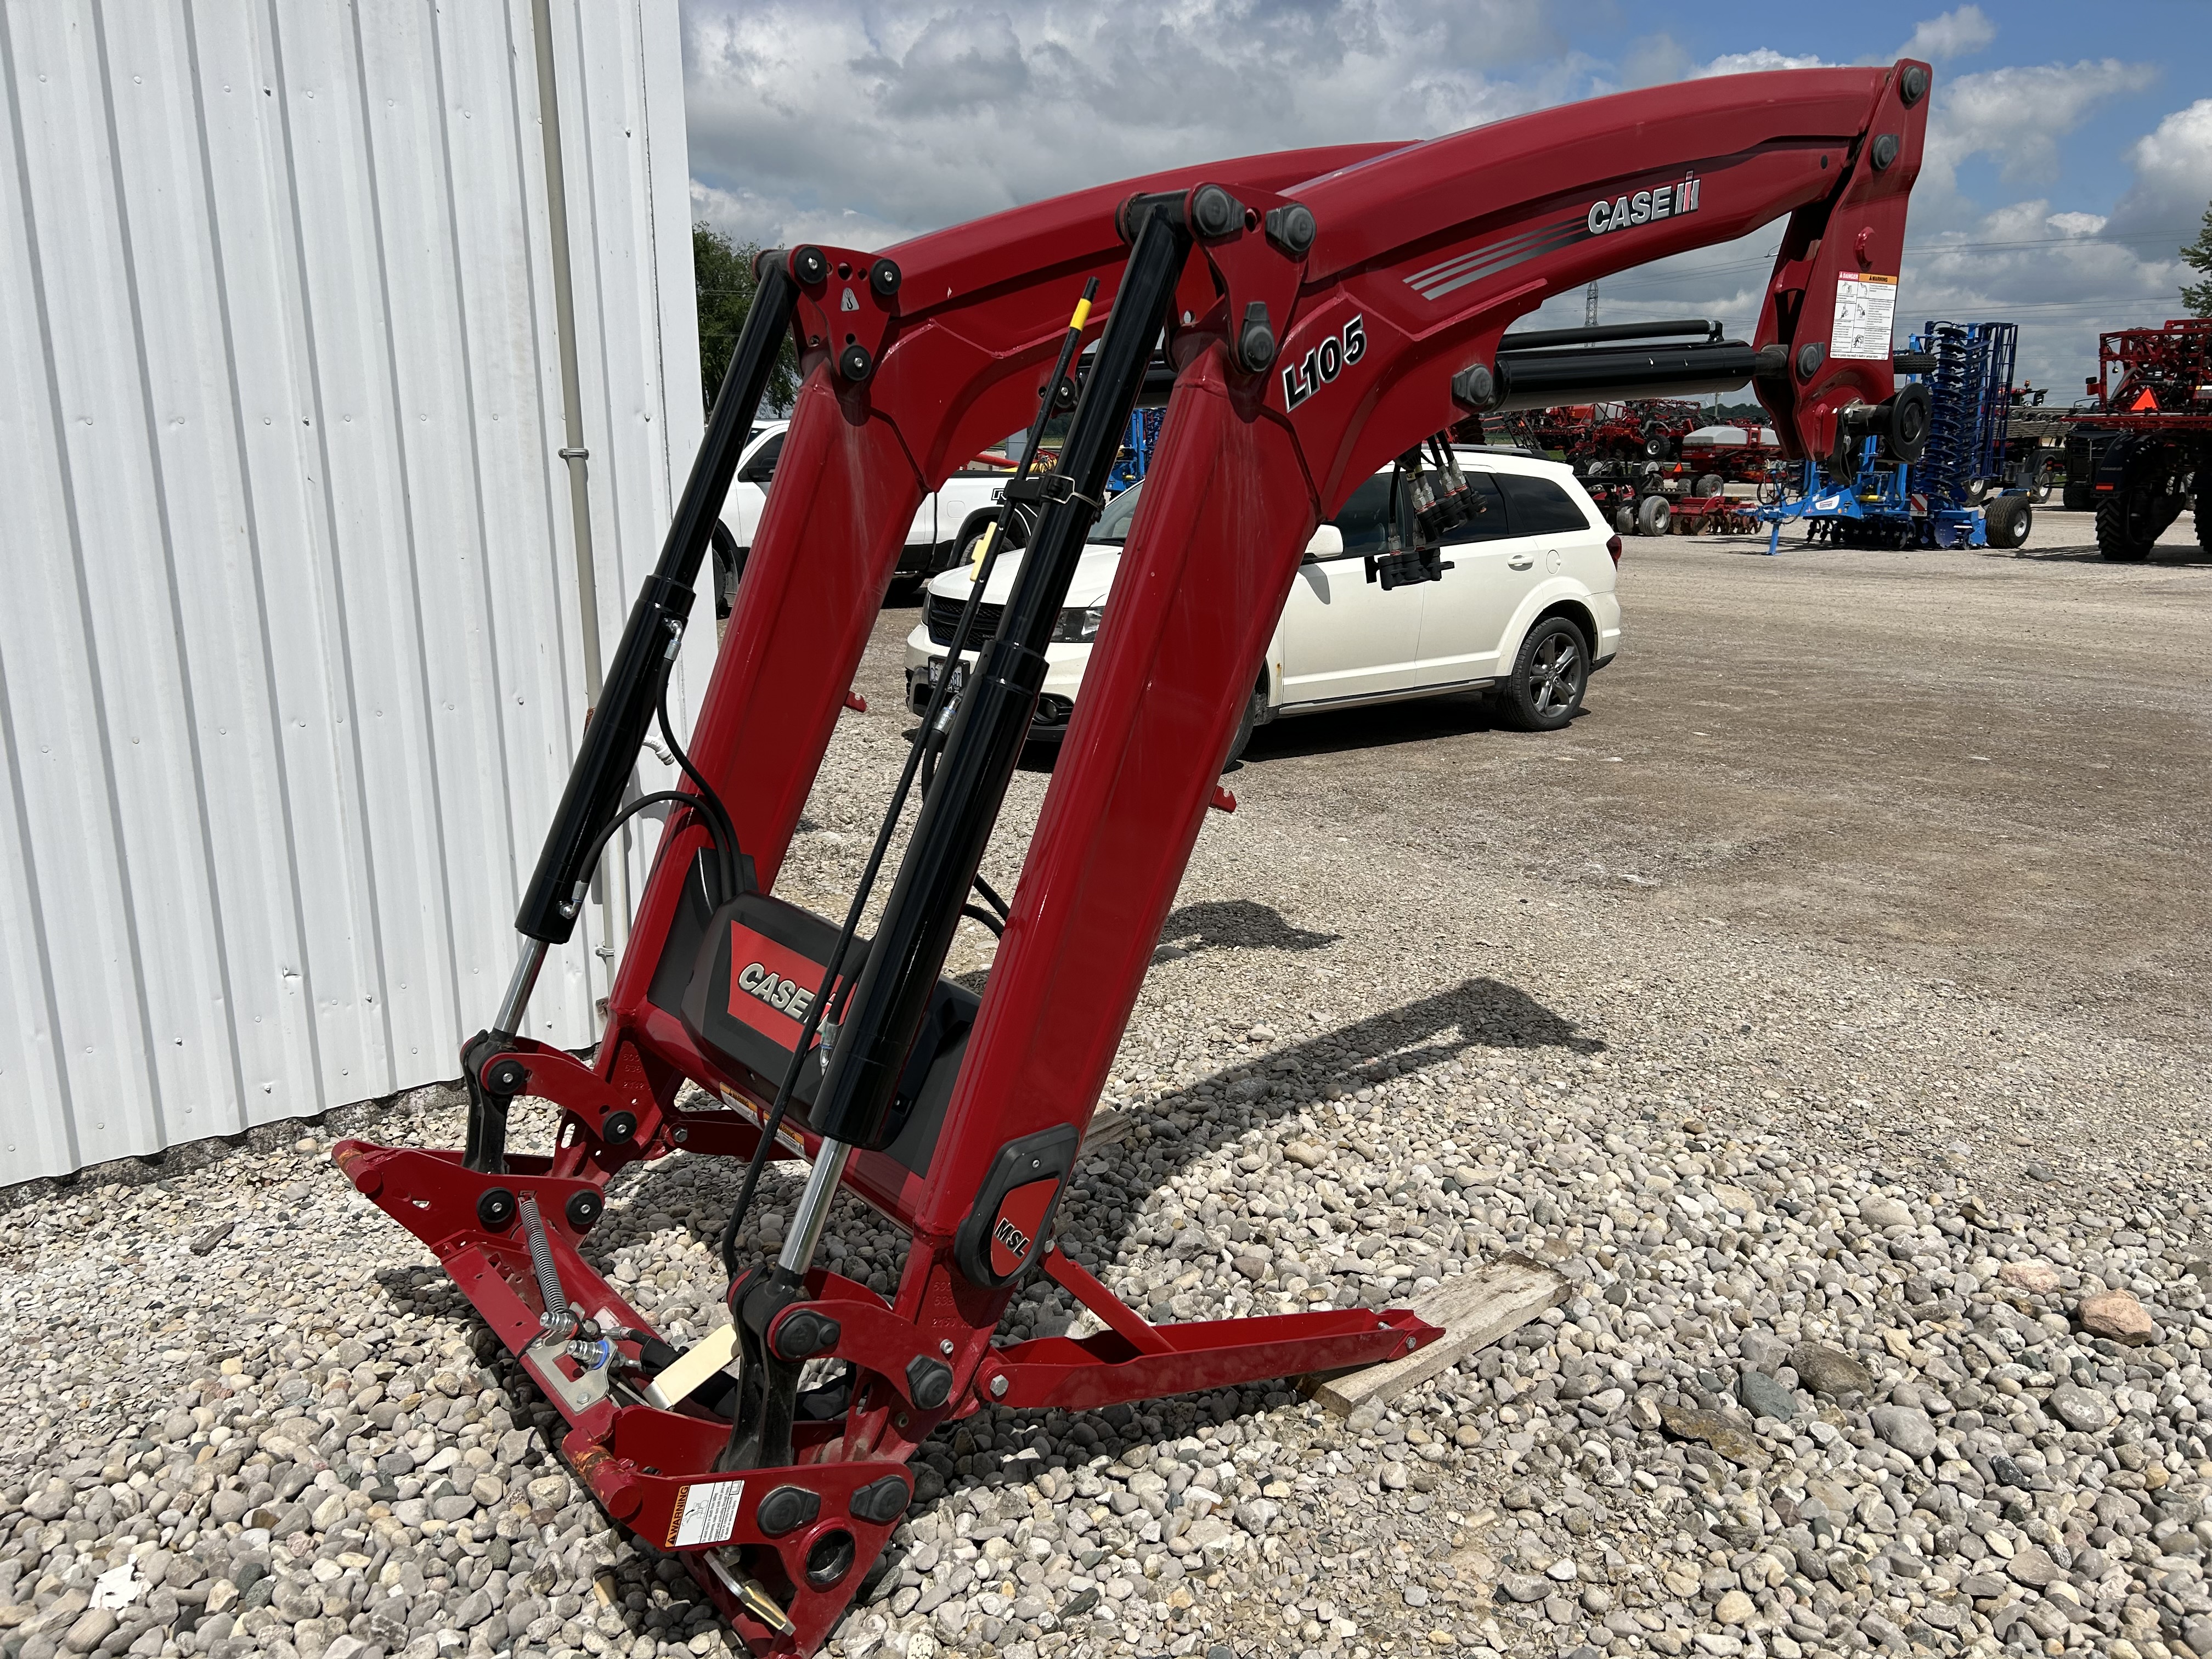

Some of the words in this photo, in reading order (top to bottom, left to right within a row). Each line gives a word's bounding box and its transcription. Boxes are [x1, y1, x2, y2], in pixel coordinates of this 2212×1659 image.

[1588, 186, 1672, 235] CASE
[1282, 312, 1367, 414] L105
[738, 963, 815, 1019] CASE
[994, 1217, 1031, 1260] MSL
[670, 1486, 689, 1535] WARNING
